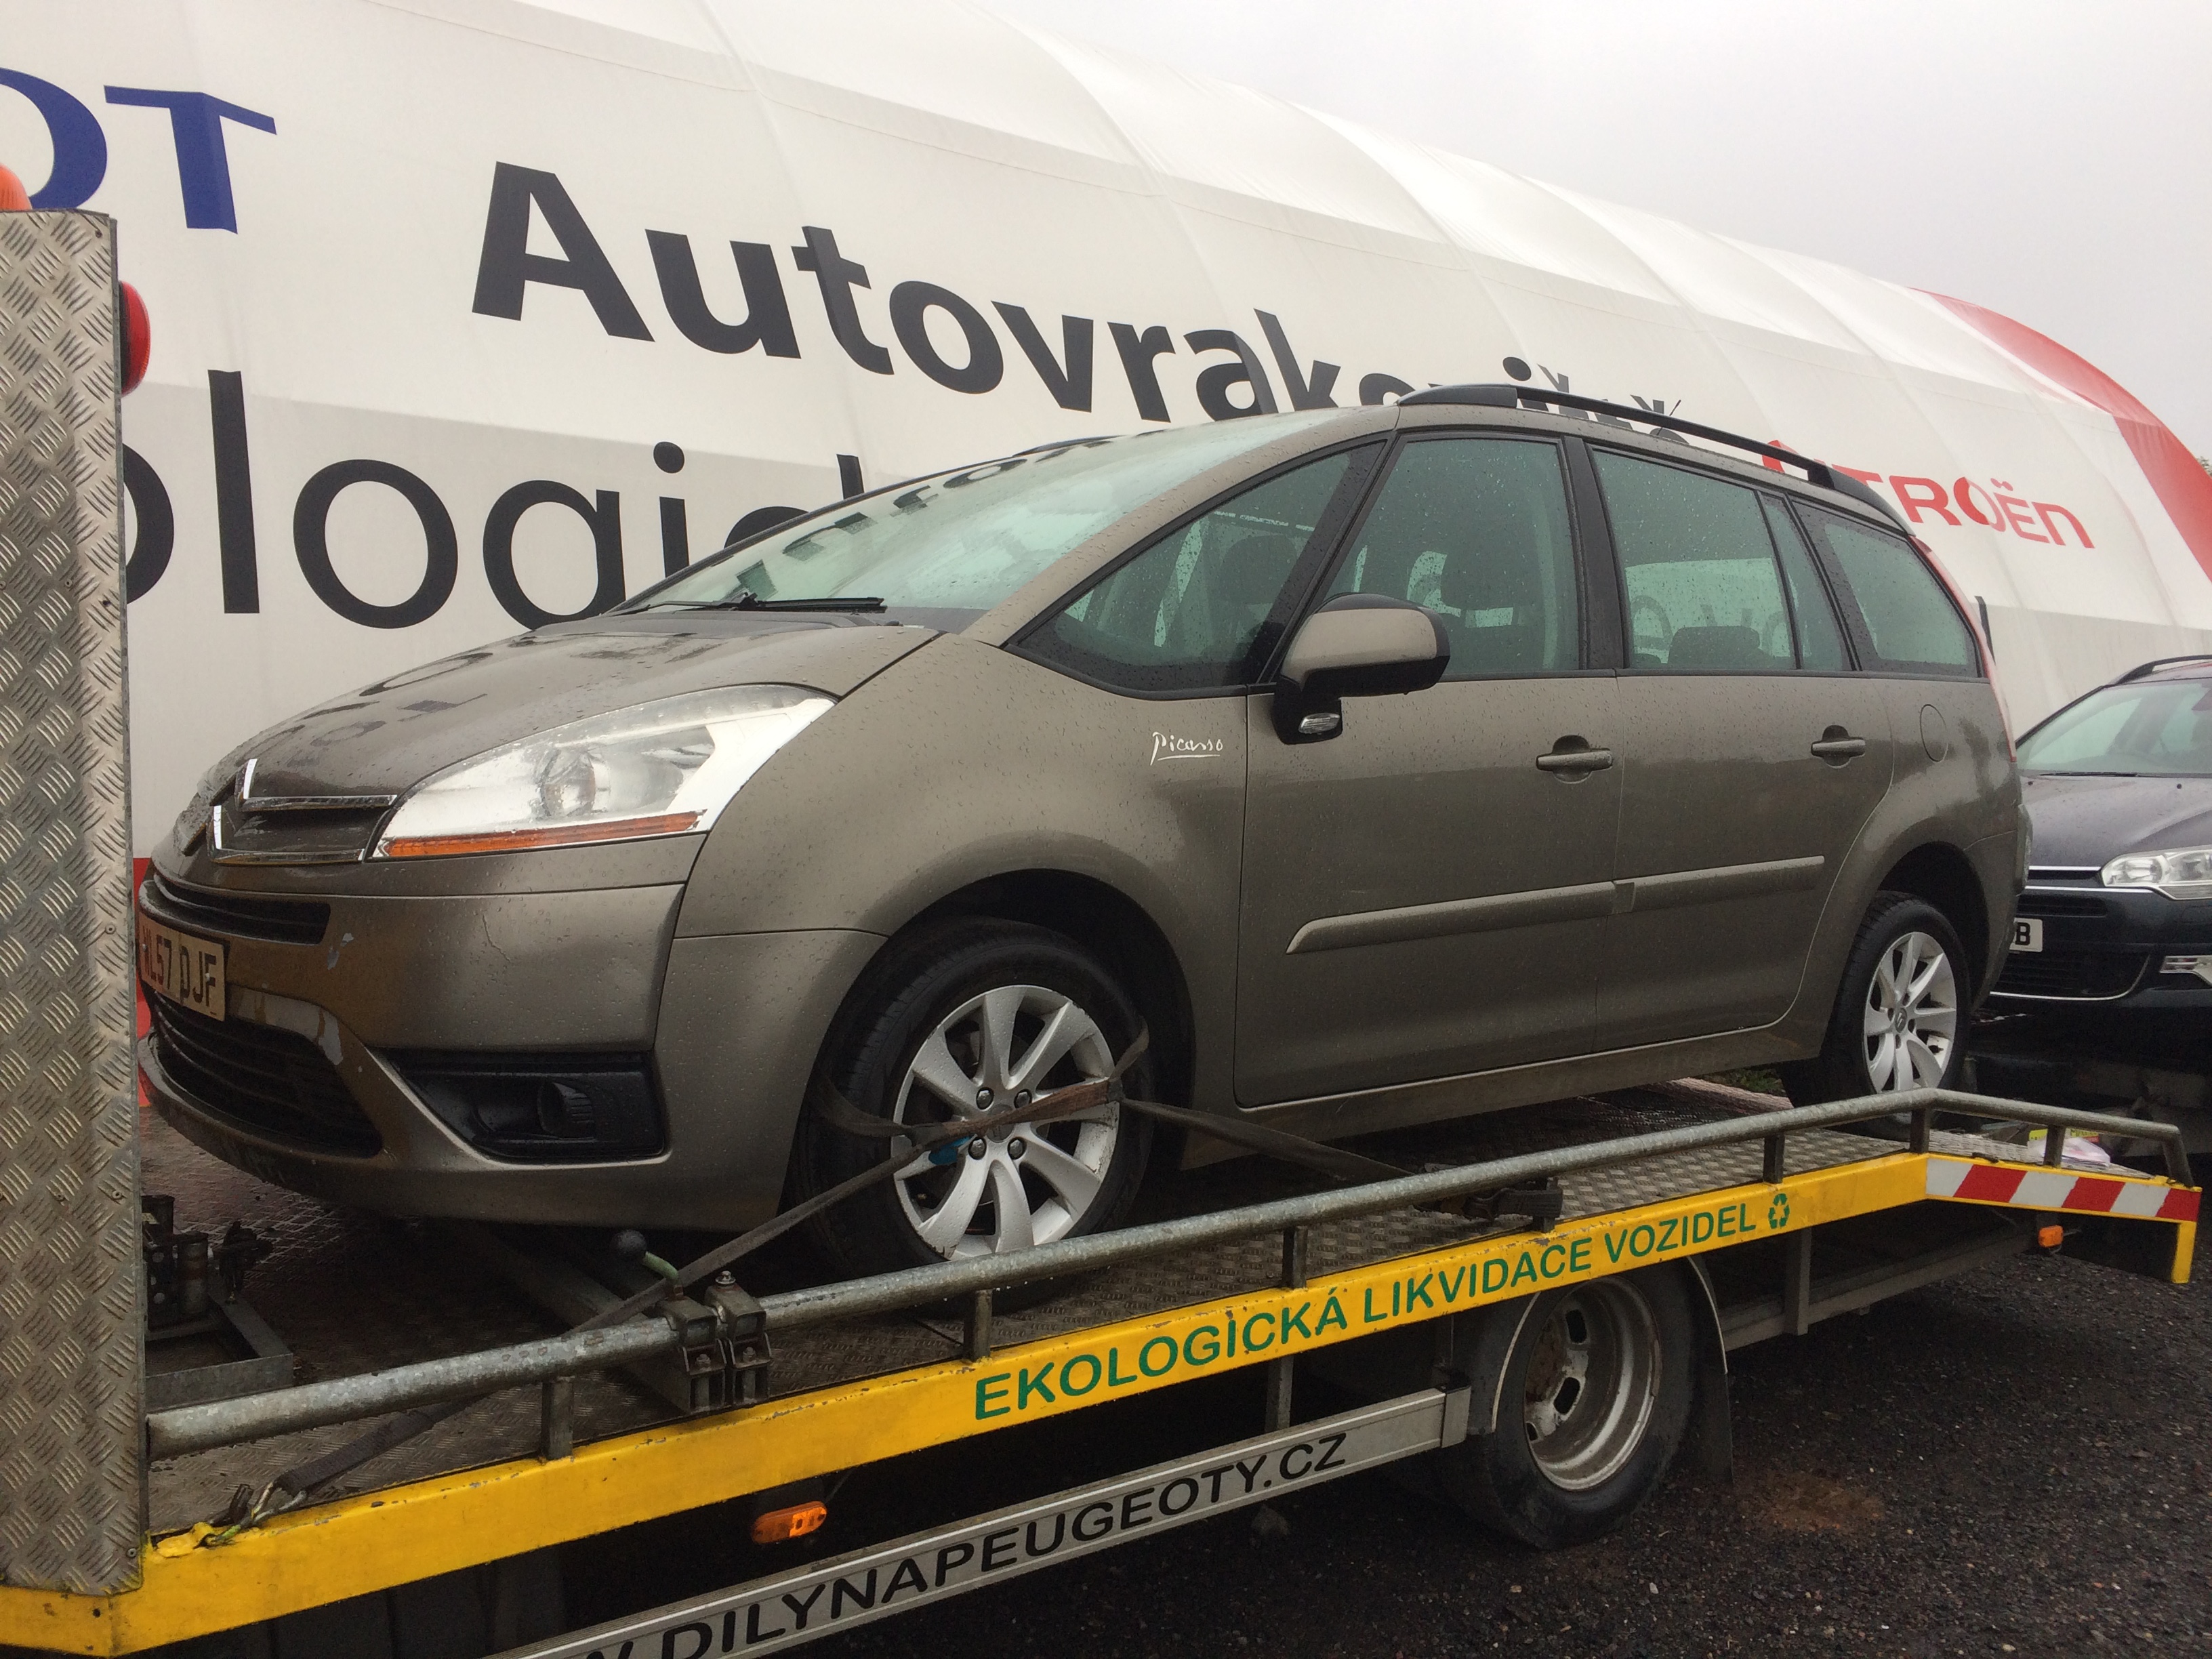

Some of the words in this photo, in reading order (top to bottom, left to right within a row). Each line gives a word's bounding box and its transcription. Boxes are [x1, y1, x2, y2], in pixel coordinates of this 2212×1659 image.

[472, 161, 1689, 445] Autovrak
[120, 369, 865, 630] logi
[1762, 439, 2095, 549] ROËN
[1149, 731, 1223, 766] Picasso
[975, 1287, 1348, 1420] EKOLOGICKÁ
[1362, 1237, 1592, 1324] LIKVIDACE
[1605, 1202, 1757, 1265] VOZIDEL
